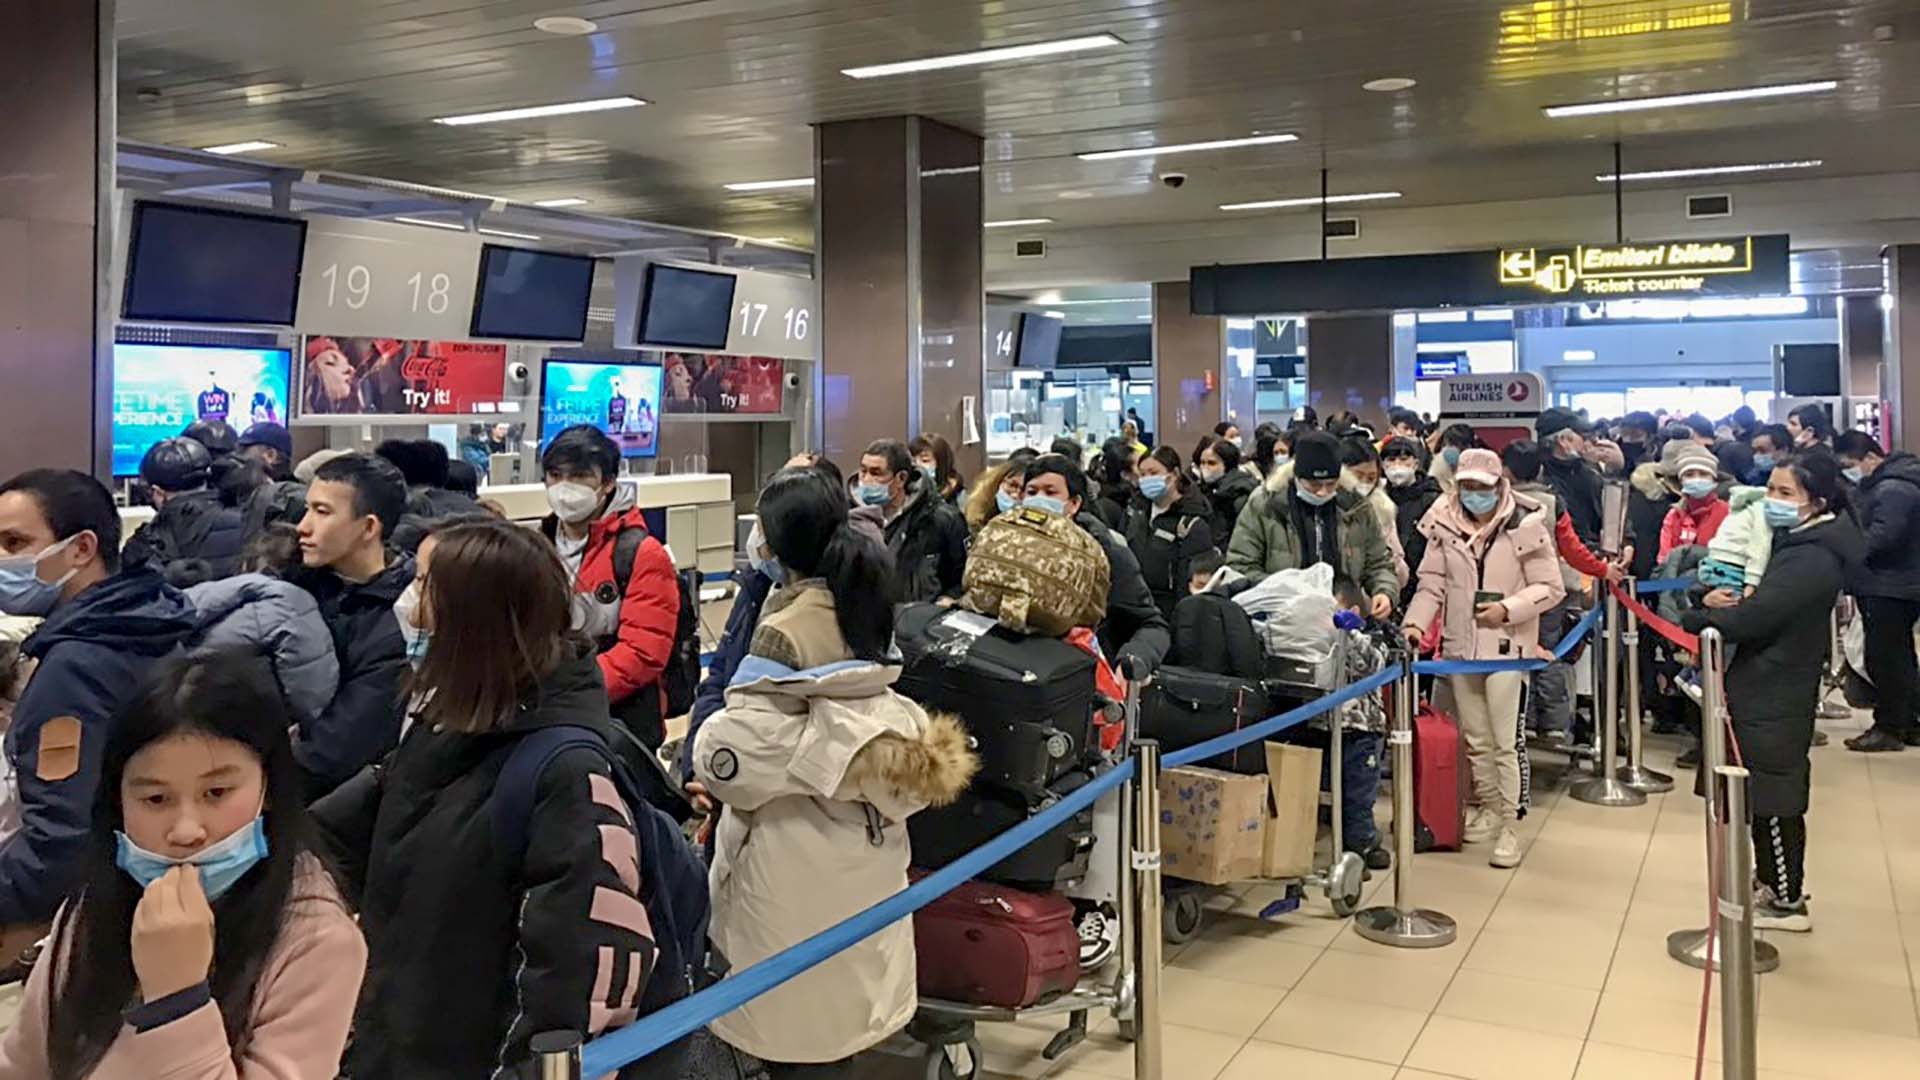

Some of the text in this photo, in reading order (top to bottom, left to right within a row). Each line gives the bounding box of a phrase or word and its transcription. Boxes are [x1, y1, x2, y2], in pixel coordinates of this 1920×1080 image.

[321, 264, 370, 309] 19
[408, 272, 449, 314] 18
[1583, 276, 1704, 294] Ticket counter
[740, 303, 768, 337] 17
[784, 308, 809, 340] 16
[996, 330, 1013, 356] 14
[402, 388, 451, 408] Try it!
[1448, 382, 1503, 392] TURKISH
[1448, 392, 1503, 402] AIRLINES
[720, 393, 738, 409] Try
